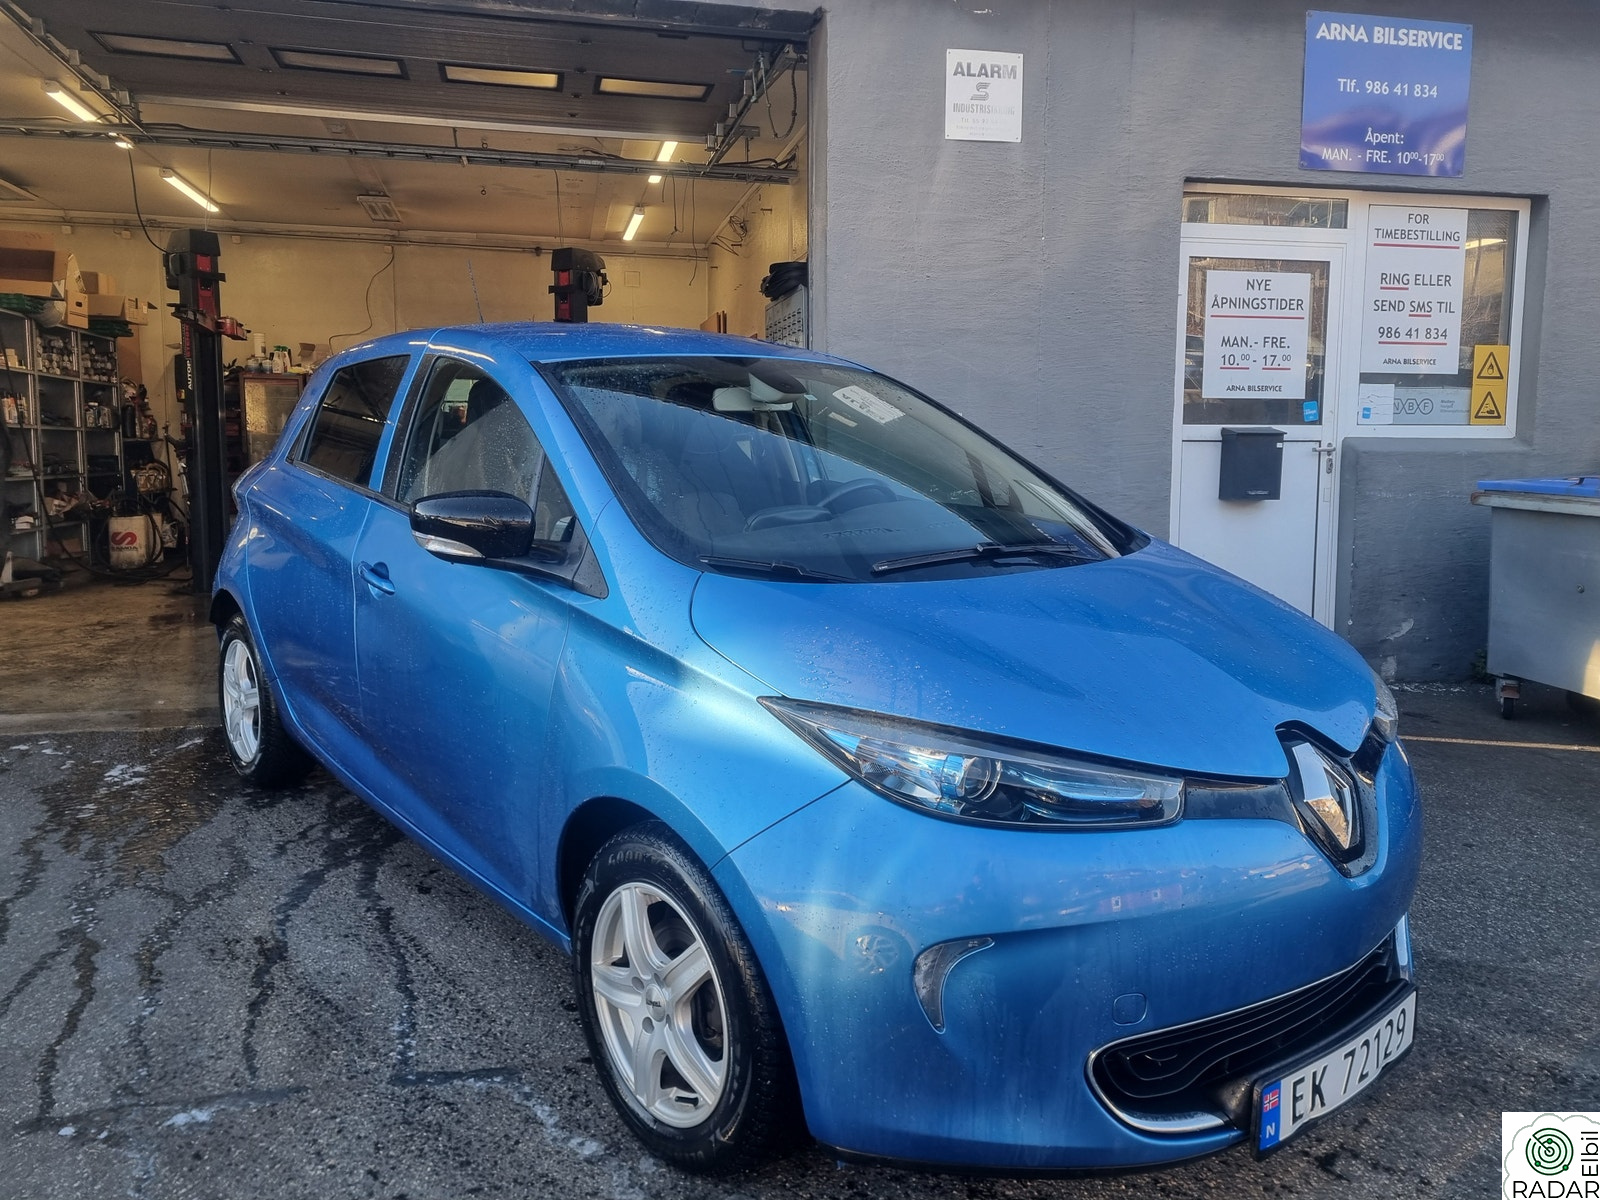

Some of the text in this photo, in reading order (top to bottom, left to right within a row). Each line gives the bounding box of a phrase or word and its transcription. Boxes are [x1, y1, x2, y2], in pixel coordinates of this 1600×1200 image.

[1316, 22, 1463, 50] ARNA BILSERVICE
[953, 61, 1017, 79] ALARM
[1338, 78, 1438, 98] Tlf. 986 41 834
[1364, 127, 1404, 145] Åpent:
[1322, 148, 1352, 161] MAN.
[1366, 150, 1392, 163] FRE.
[1408, 213, 1430, 224] FOR
[1374, 228, 1461, 242] TIMEBESTILLING
[1246, 279, 1272, 291] NYE
[1380, 272, 1452, 287] RING ELLER
[1211, 294, 1304, 311] ÅPNINGSTIDER
[1373, 299, 1456, 314] SEND SMS TIL
[1378, 326, 1448, 340] 986 41 834
[1263, 336, 1291, 349] FRE.
[1291, 1008, 1407, 1126] EK 72129
[1266, 1122, 1276, 1139] N
